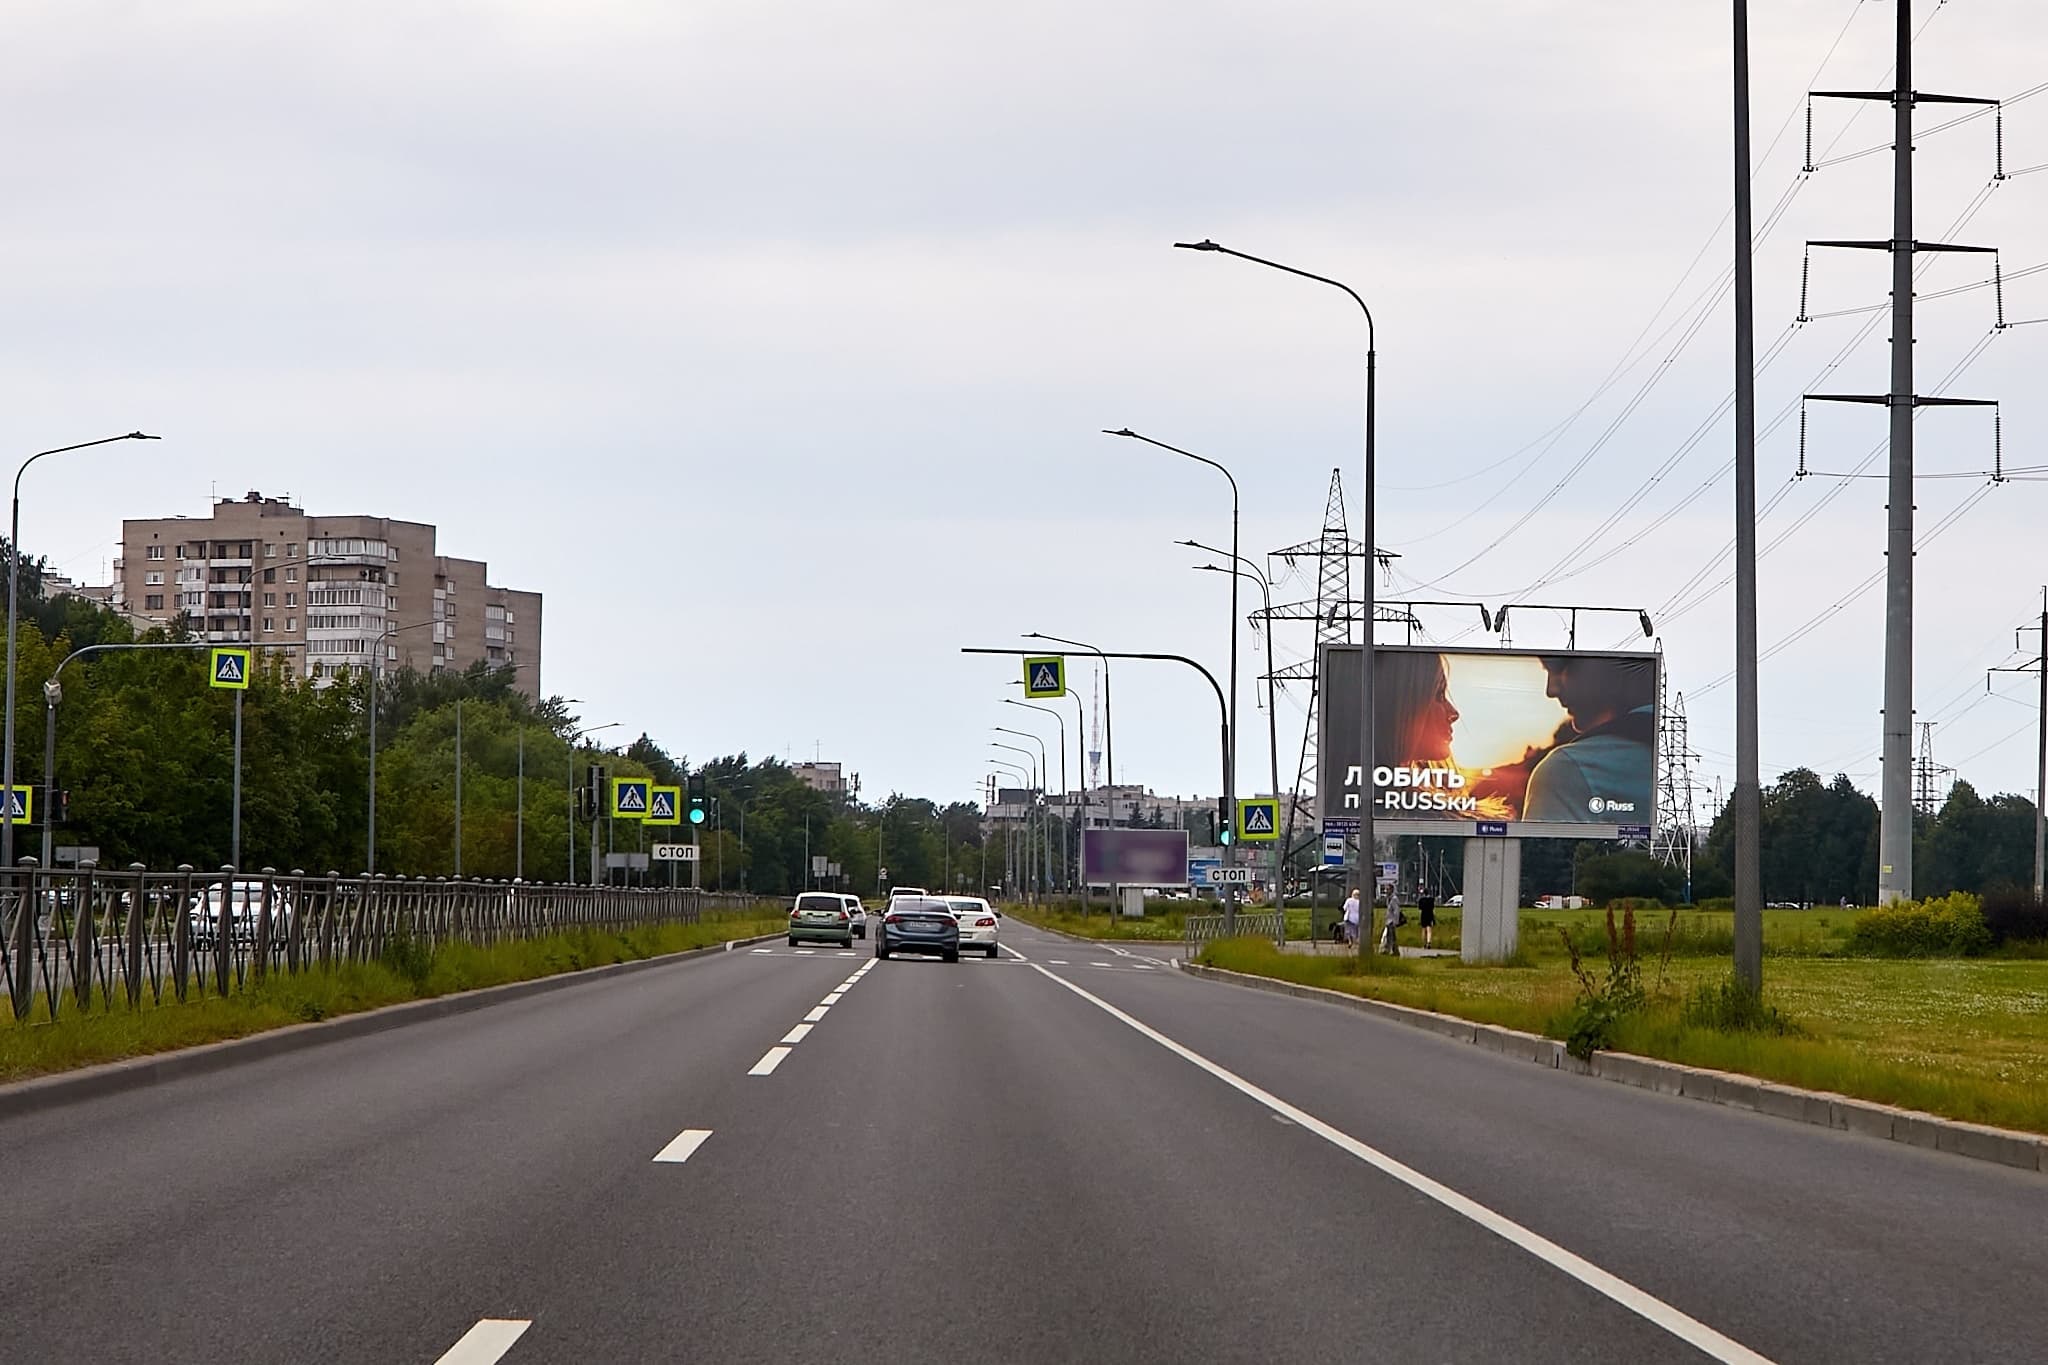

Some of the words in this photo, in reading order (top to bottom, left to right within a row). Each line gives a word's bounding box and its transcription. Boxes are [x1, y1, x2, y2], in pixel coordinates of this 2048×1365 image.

[1344, 791, 1477, 811] п-RUSSки
[1606, 800, 1635, 811] Russ
[658, 846, 694, 858] СТОП
[1212, 870, 1246, 881] СТОП
